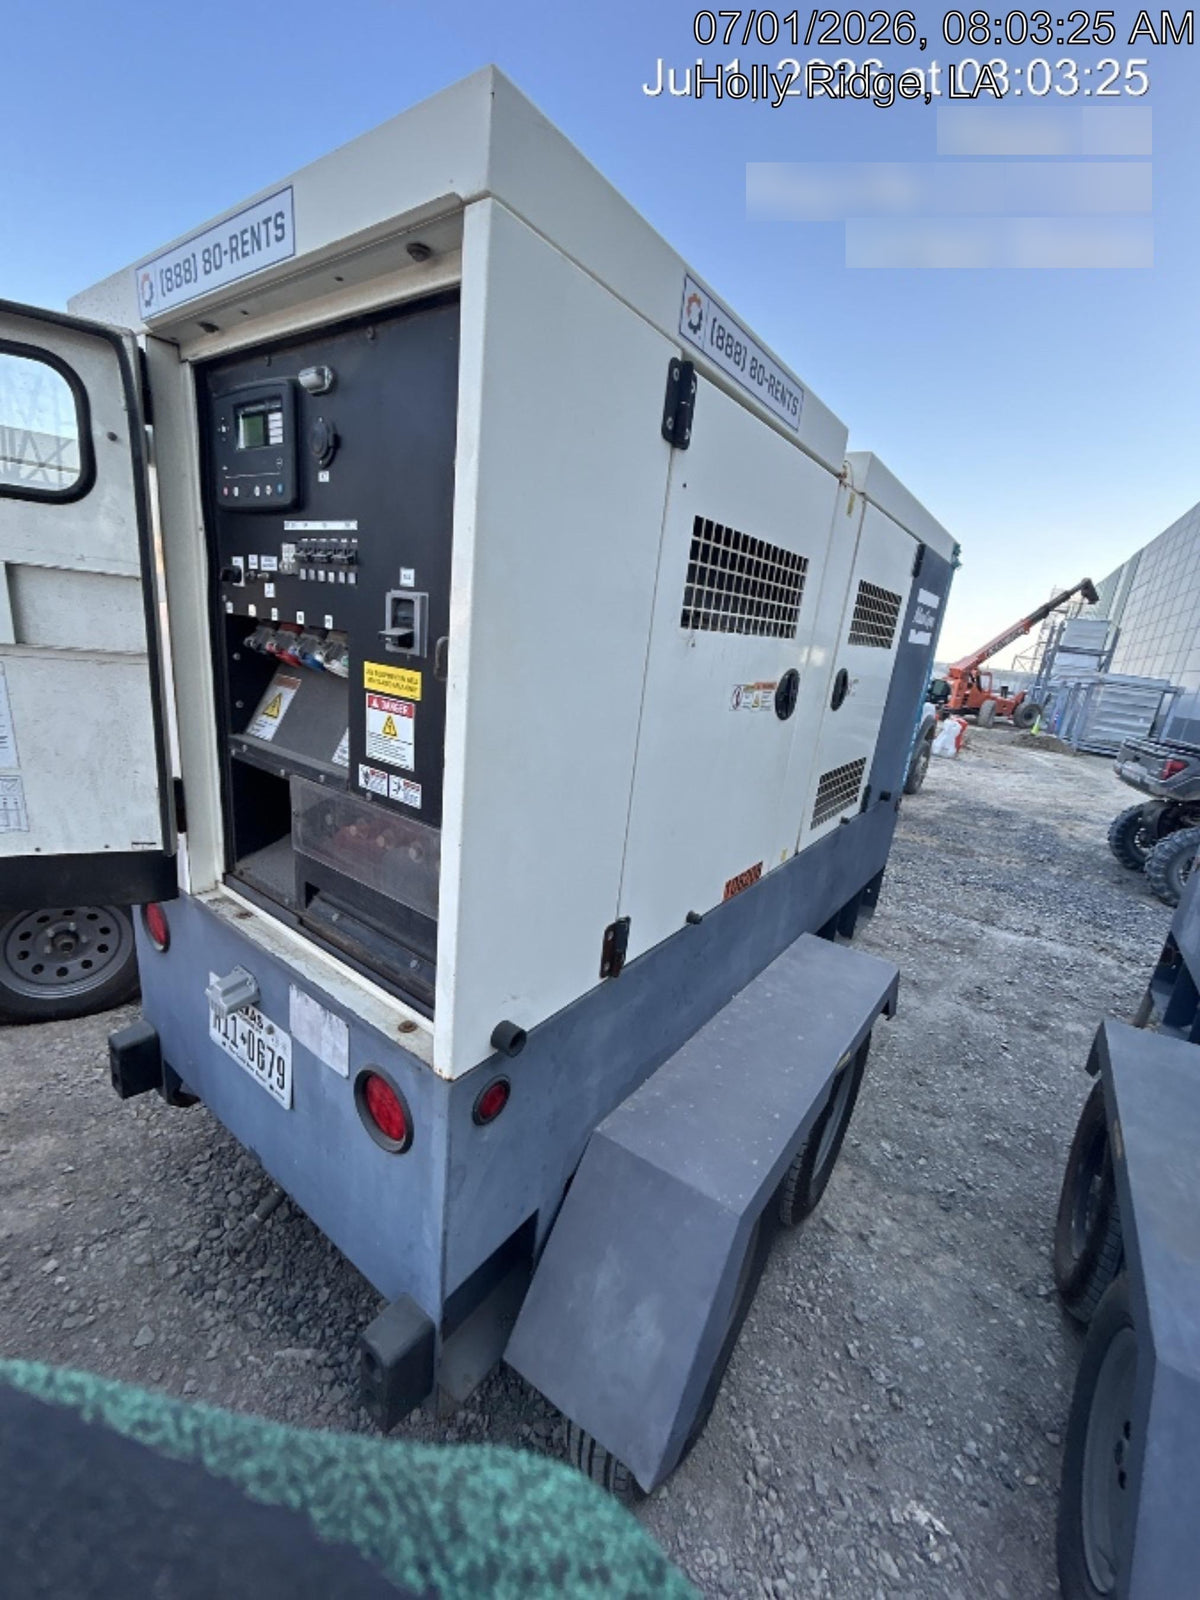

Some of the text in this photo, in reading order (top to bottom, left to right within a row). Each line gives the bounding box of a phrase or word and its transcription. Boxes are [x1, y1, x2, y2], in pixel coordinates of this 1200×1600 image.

[159, 210, 286, 298] (888) 80-RENTS
[710, 317, 800, 417] (888) 80-RENTS
